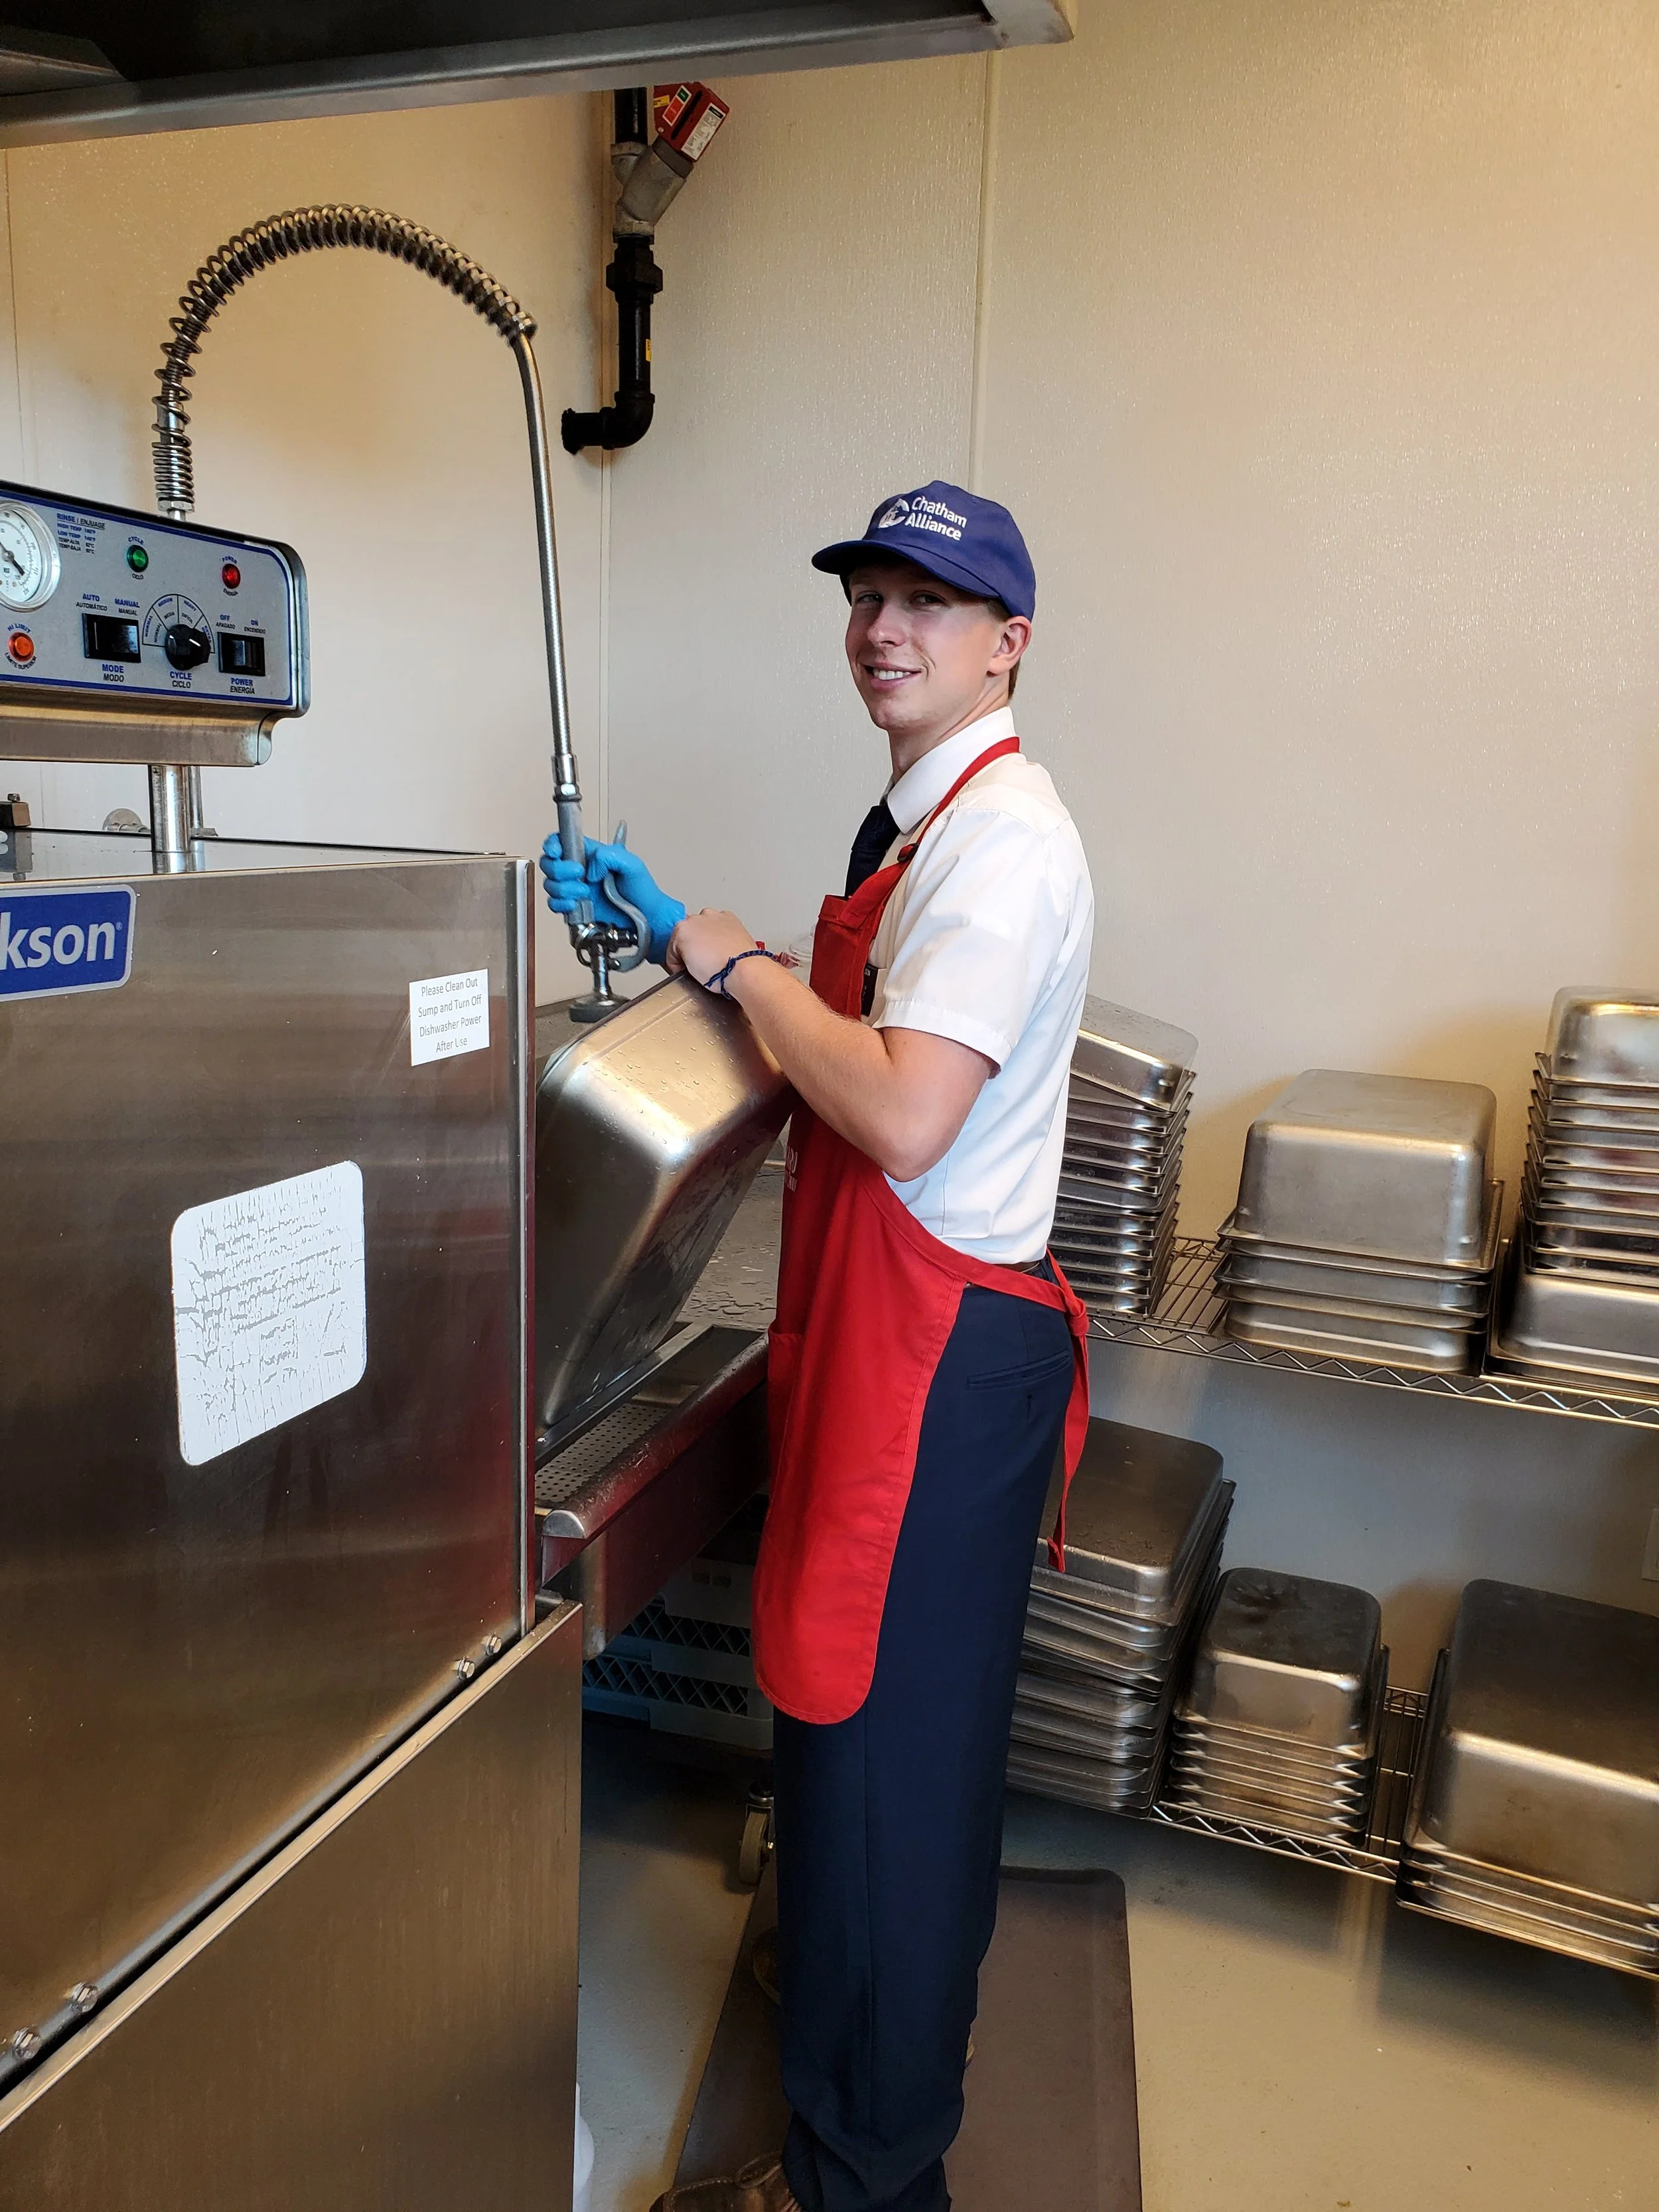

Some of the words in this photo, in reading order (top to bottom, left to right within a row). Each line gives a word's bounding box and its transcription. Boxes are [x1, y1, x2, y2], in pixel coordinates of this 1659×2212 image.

[912, 495, 967, 528] Chatham
[56, 513, 76, 523] RINSE
[80, 518, 106, 530] ENJUAGE
[904, 512, 962, 541] Alliance
[127, 536, 144, 546] CYCLE
[82, 593, 100, 602] AUTO
[114, 598, 140, 608] MANUAL
[118, 607, 138, 616] MANUAL
[102, 664, 125, 674] MODE
[103, 673, 125, 683] MODO
[169, 671, 192, 680] CYCLE
[172, 680, 191, 689] CICLO
[230, 678, 253, 686] POWER
[421, 985, 444, 997] Please
[445, 981, 464, 992] Clean
[465, 978, 478, 988] Out
[418, 1006, 439, 1017] Sump
[439, 1000, 453, 1013] and
[454, 999, 470, 1009] Turn
[471, 994, 482, 1006] Off
[419, 1019, 459, 1037] Dishwasher
[461, 1015, 482, 1028] Power
[435, 1040, 454, 1053] After
